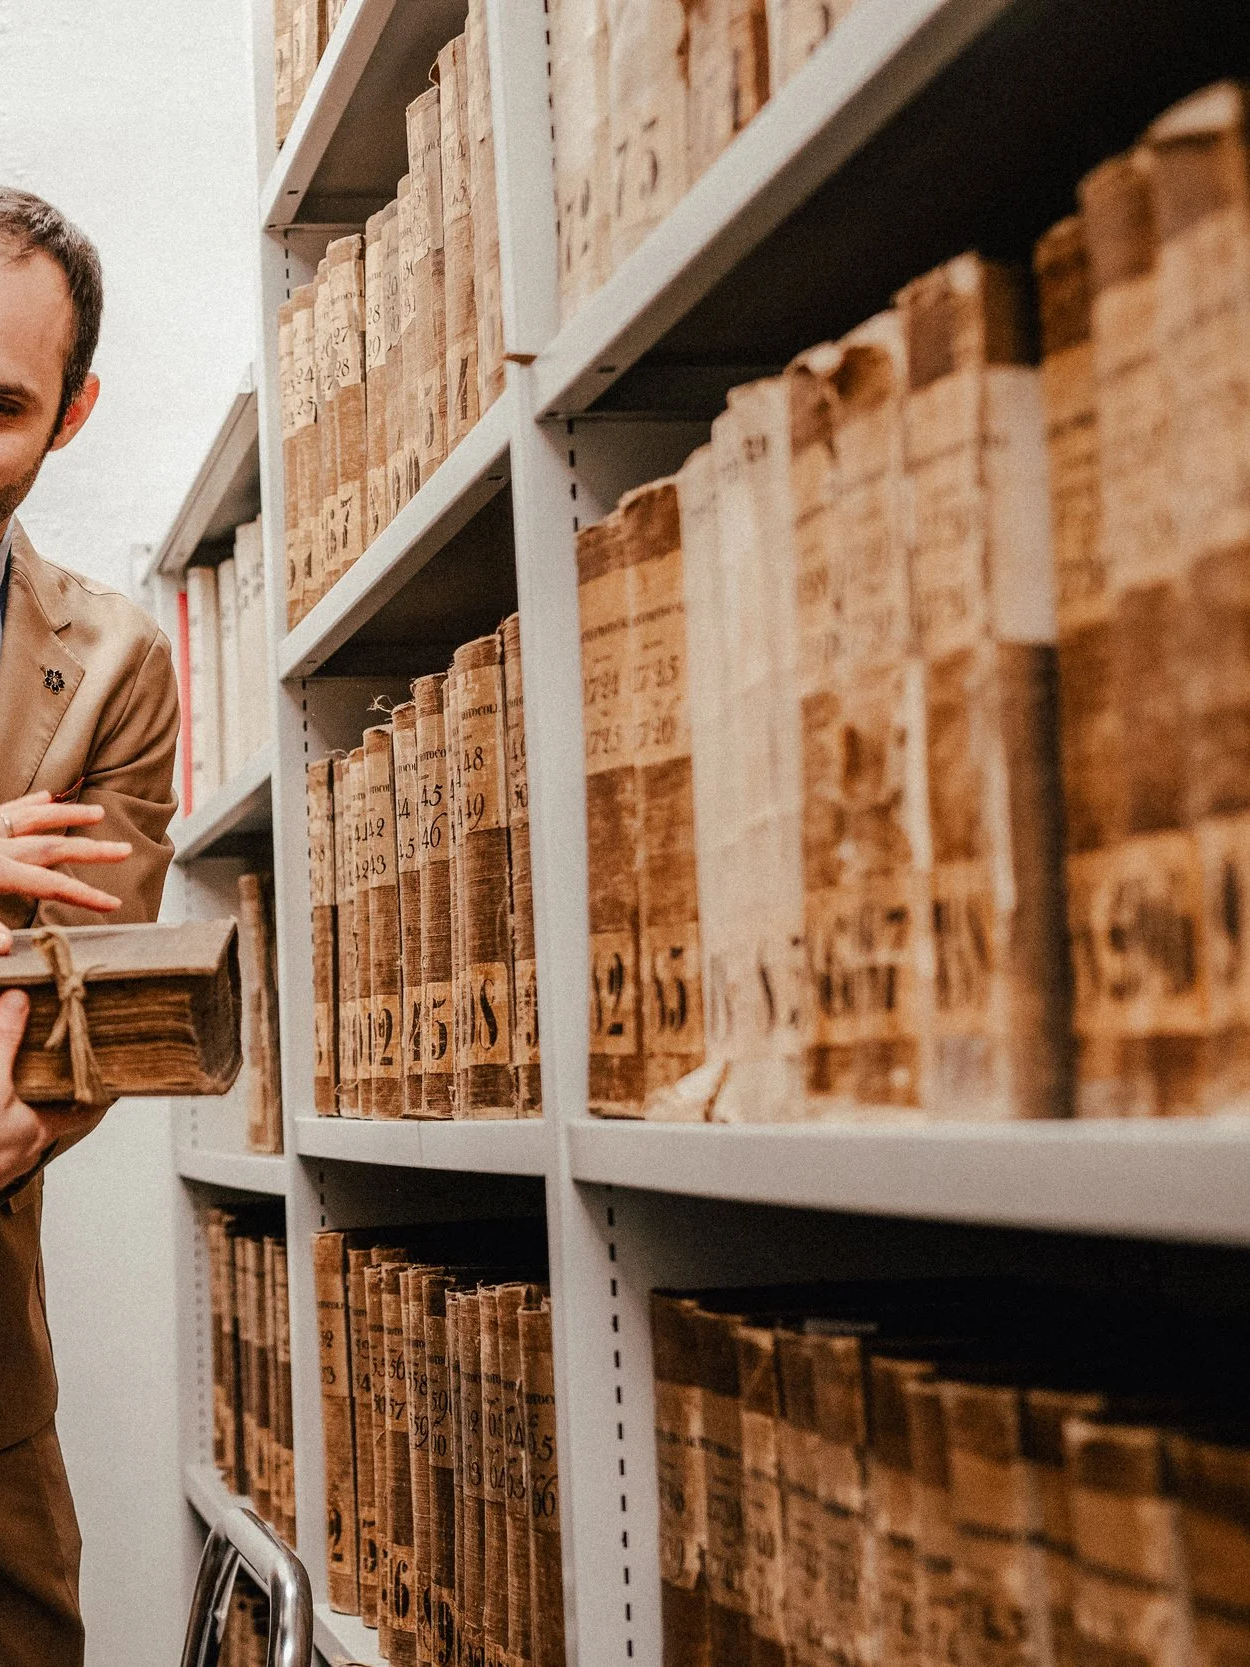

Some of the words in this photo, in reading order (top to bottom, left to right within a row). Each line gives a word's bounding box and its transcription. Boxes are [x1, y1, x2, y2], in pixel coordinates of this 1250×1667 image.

[463, 746, 485, 773] 48
[421, 784, 443, 807] 45
[464, 792, 486, 832] 49
[368, 817, 385, 838] 42
[421, 812, 448, 849] 46
[354, 860, 370, 881] 42
[369, 854, 387, 876] 43
[387, 1352, 406, 1381] 56
